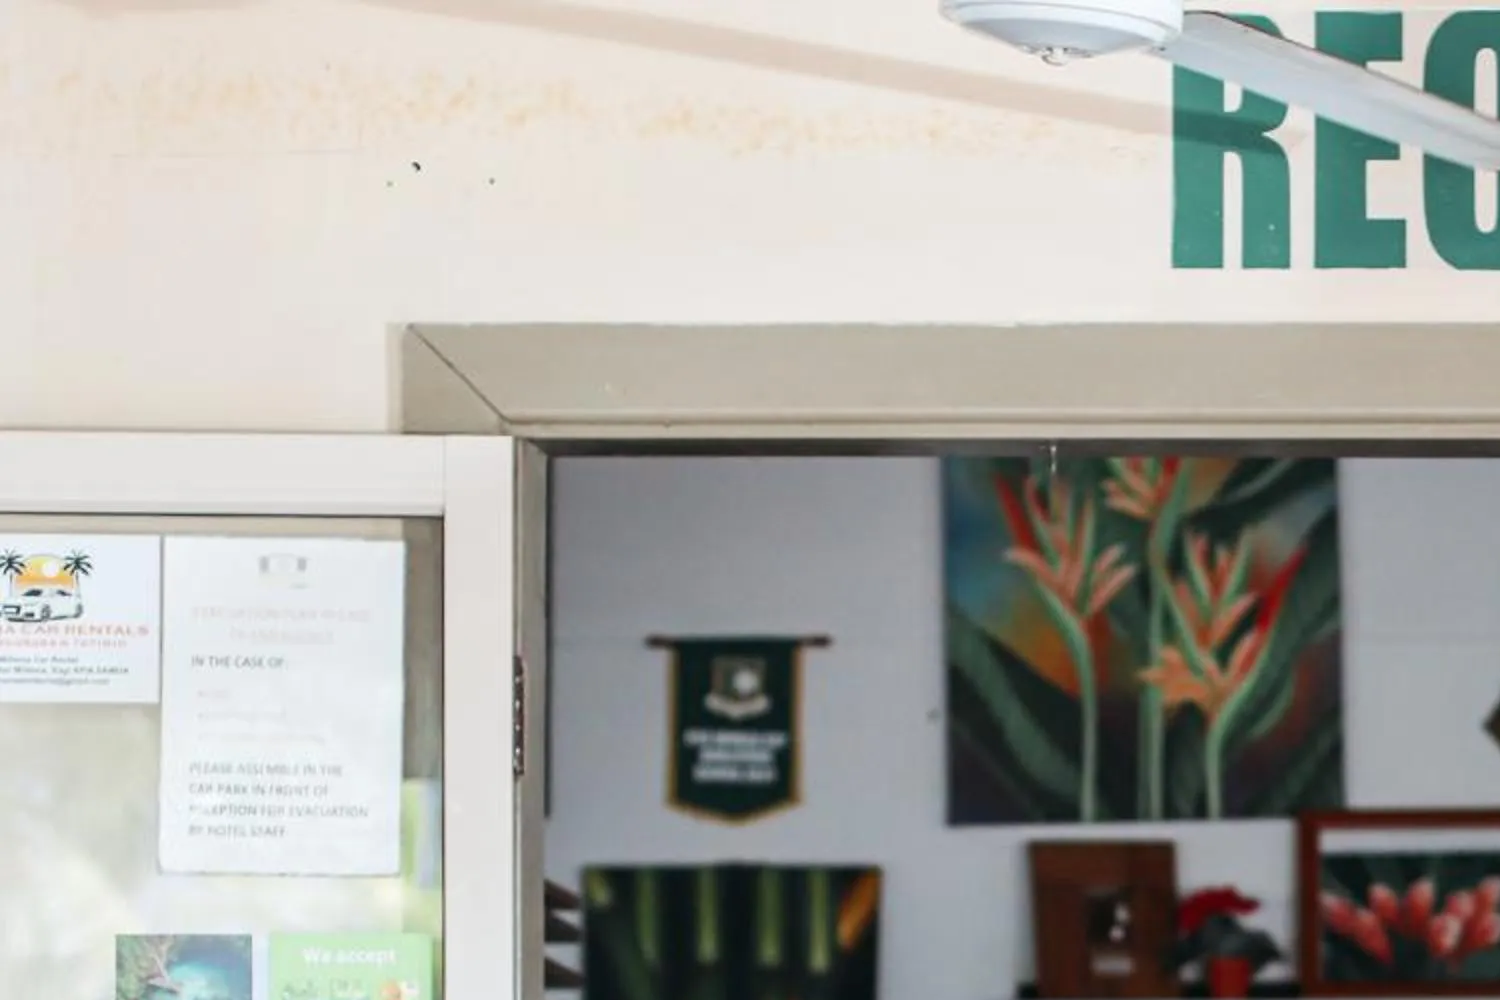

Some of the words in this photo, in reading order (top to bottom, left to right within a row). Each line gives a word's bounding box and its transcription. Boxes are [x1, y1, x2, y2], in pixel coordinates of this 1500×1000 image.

[208, 655, 230, 668] THE
[234, 655, 265, 669] CASE
[189, 762, 233, 775] PLEASE
[303, 948, 332, 965] We
[336, 947, 397, 969] accept
